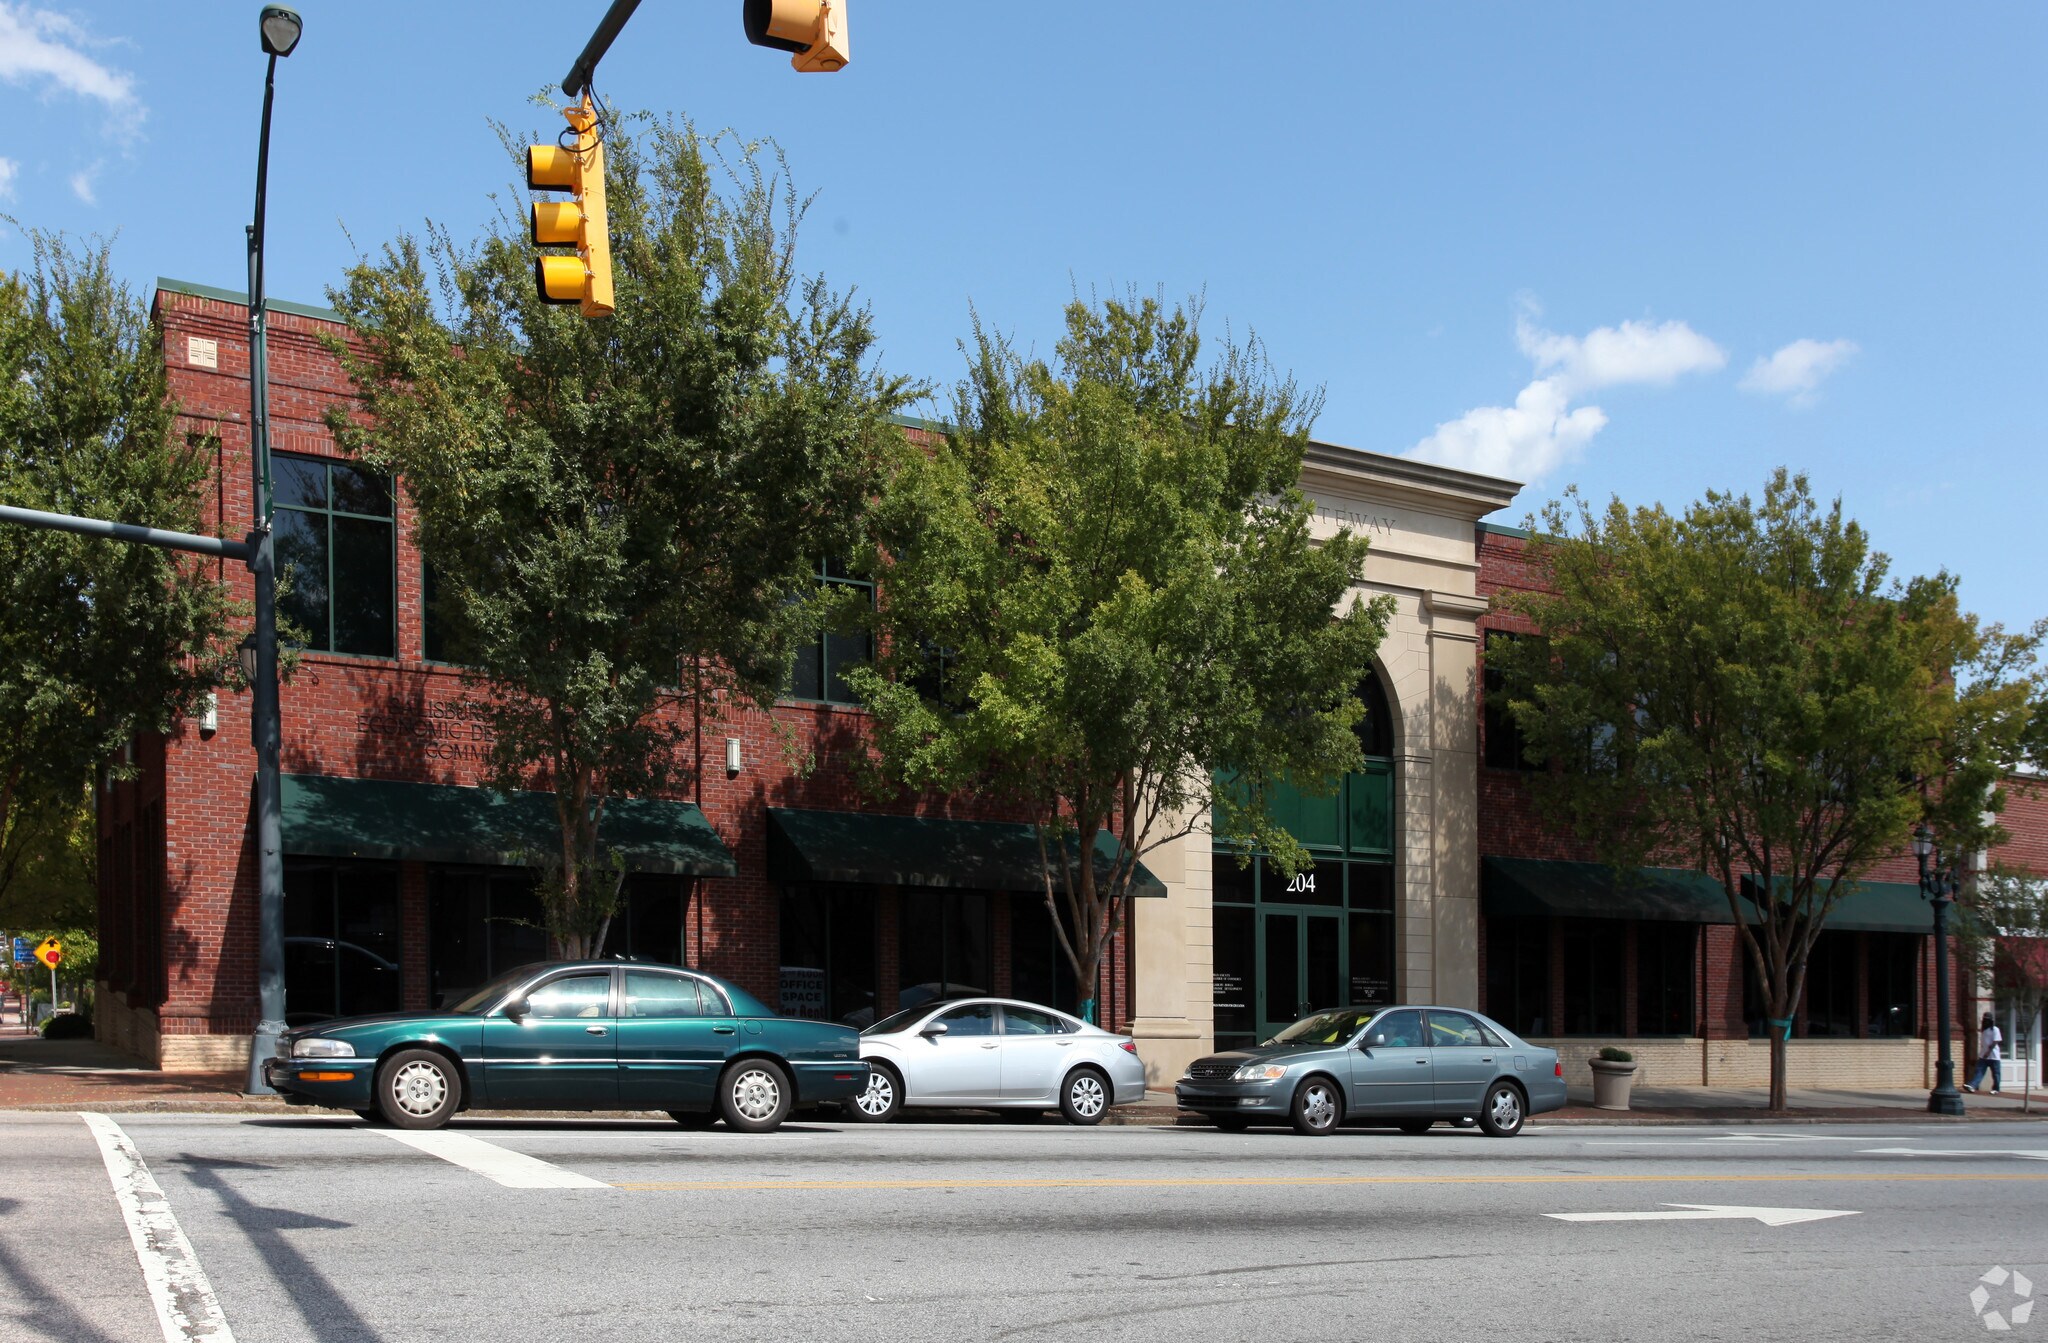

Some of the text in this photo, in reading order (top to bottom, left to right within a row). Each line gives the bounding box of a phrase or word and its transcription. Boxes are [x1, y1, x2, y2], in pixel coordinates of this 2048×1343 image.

[388, 697, 492, 722] SALISBUR
[356, 715, 462, 740] ECONOMIC
[1286, 873, 1316, 893] 204
[780, 980, 823, 990] OFFICE
[782, 992, 821, 1002] SPACE
